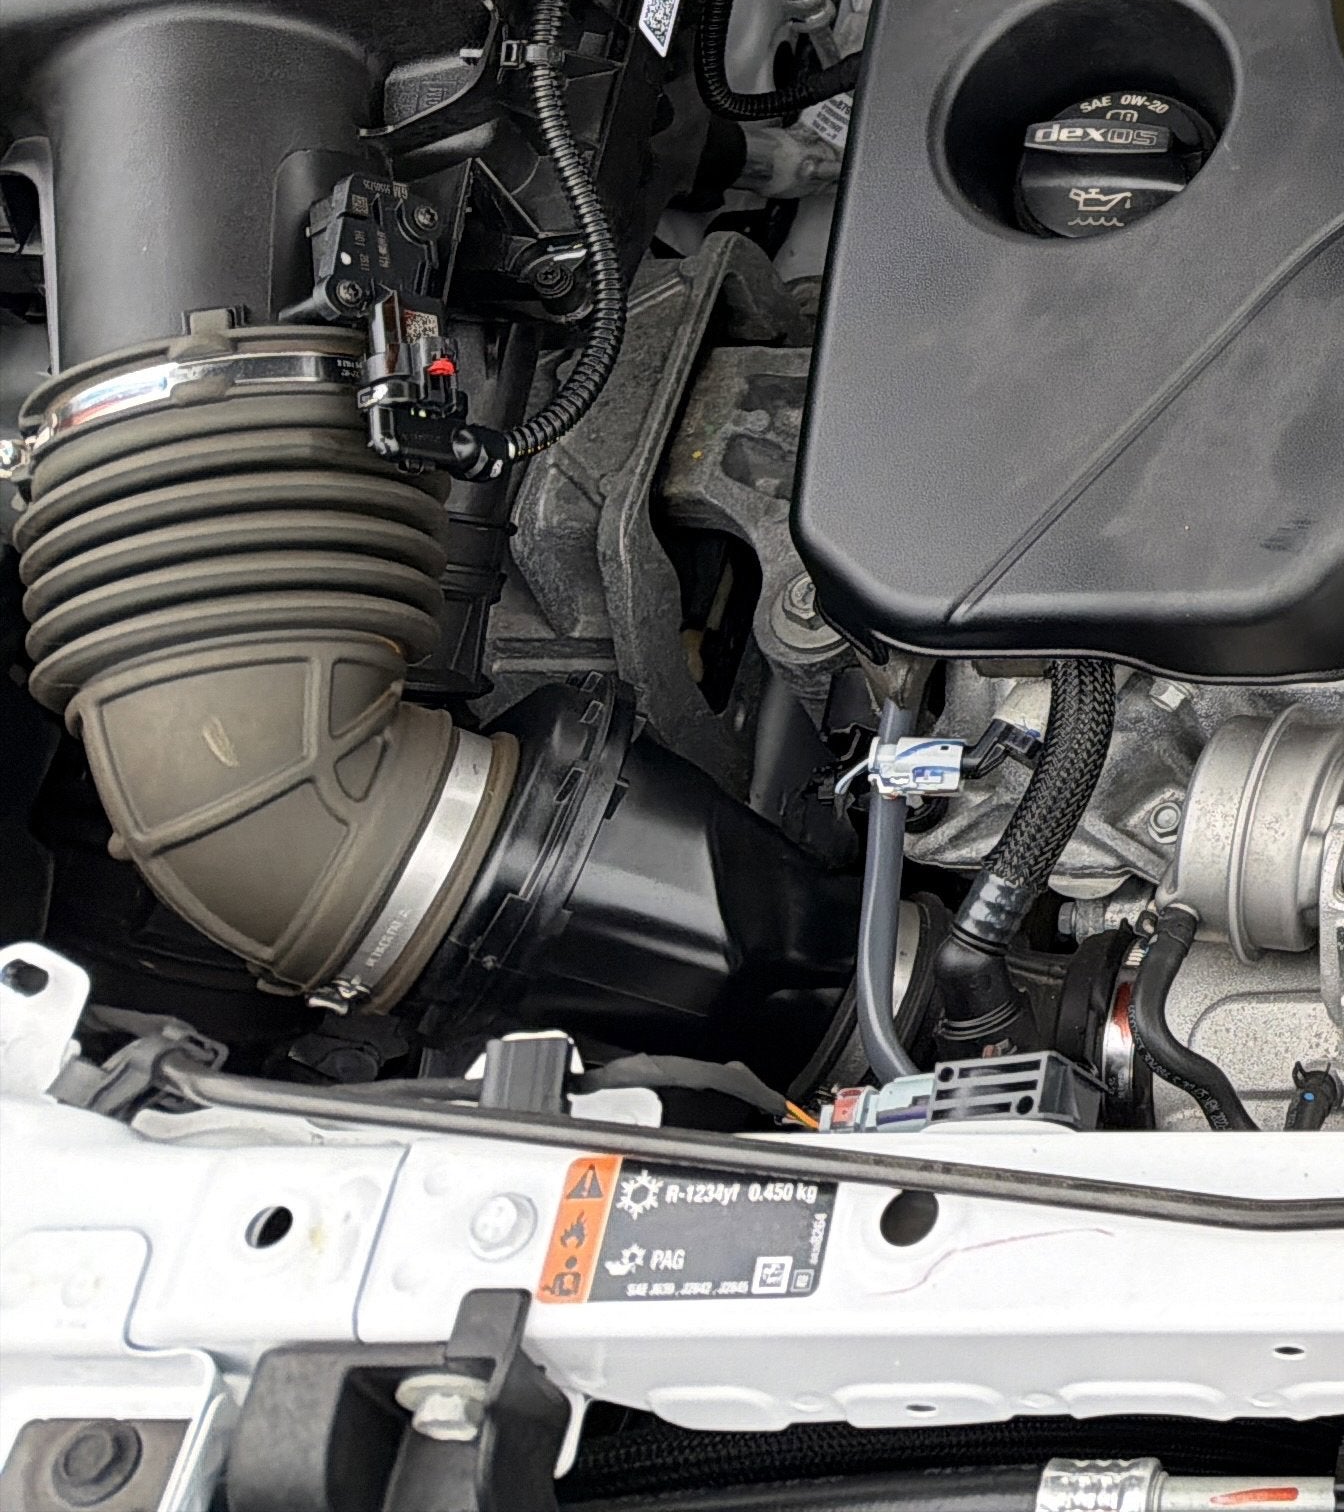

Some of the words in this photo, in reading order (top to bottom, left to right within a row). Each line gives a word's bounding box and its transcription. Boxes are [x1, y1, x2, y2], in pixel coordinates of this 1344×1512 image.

[1080, 96, 1112, 113] SAE
[1121, 94, 1169, 114] 0W-20
[1034, 124, 1158, 146] dexos
[665, 1182, 740, 1206] R-1234yf
[748, 1182, 794, 1202] 0.450
[796, 1183, 818, 1204] kg
[650, 1249, 686, 1270] PAG
